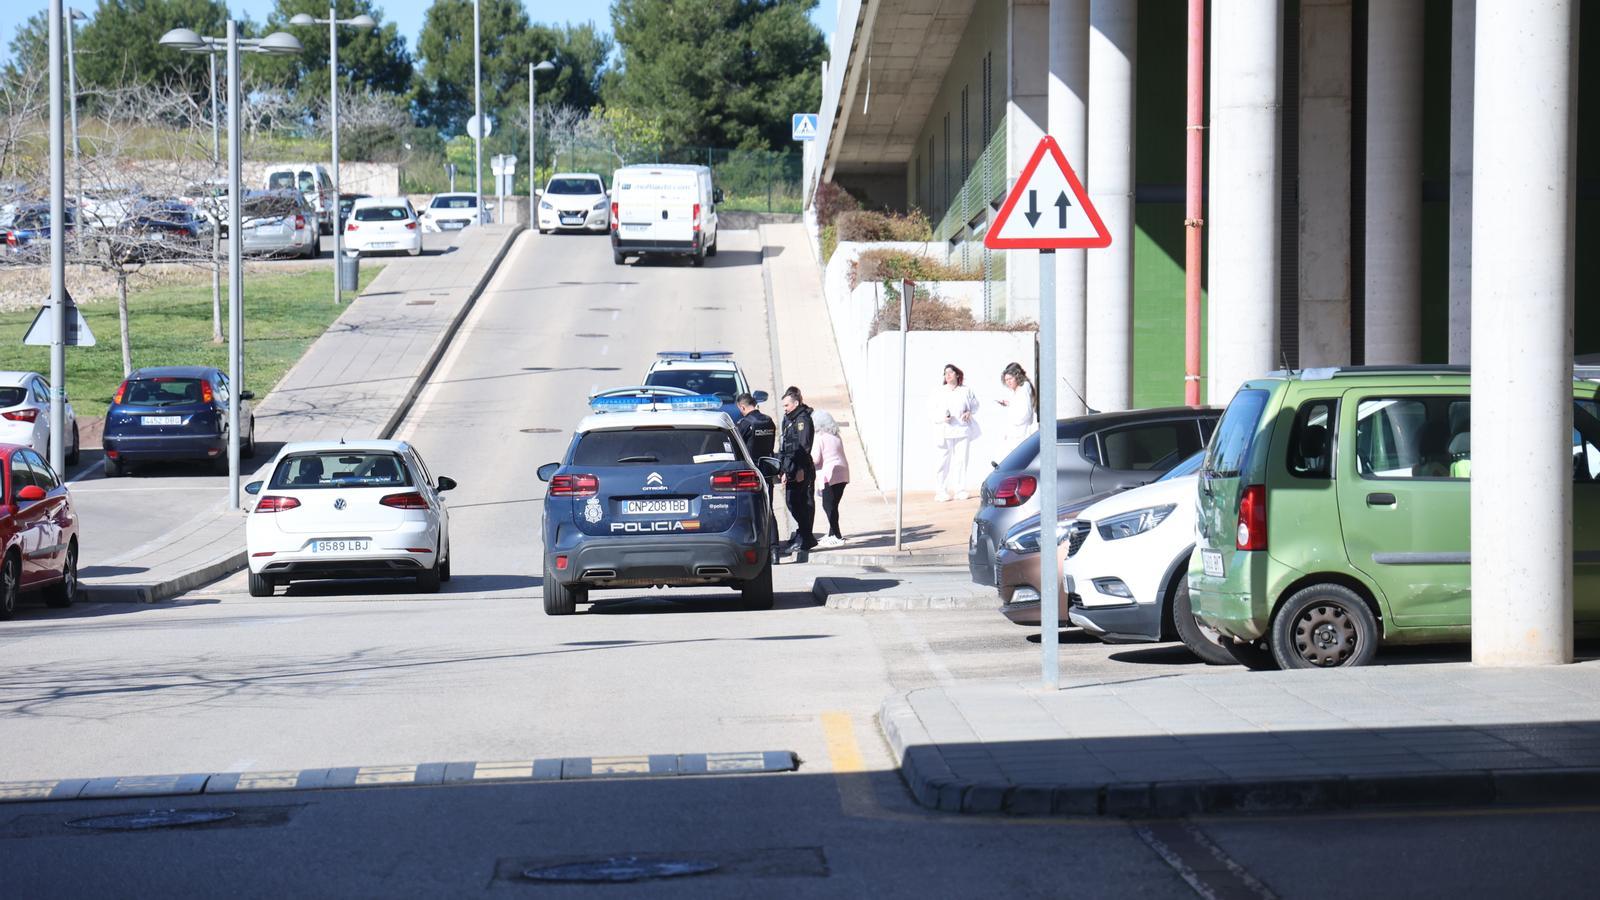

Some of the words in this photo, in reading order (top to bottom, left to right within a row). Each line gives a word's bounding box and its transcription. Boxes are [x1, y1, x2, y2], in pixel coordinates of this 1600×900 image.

[628, 500, 686, 512] CNP2081BB
[610, 520, 684, 532] POLICIA
[319, 541, 345, 551] 9589
[348, 541, 369, 551] LBJ
